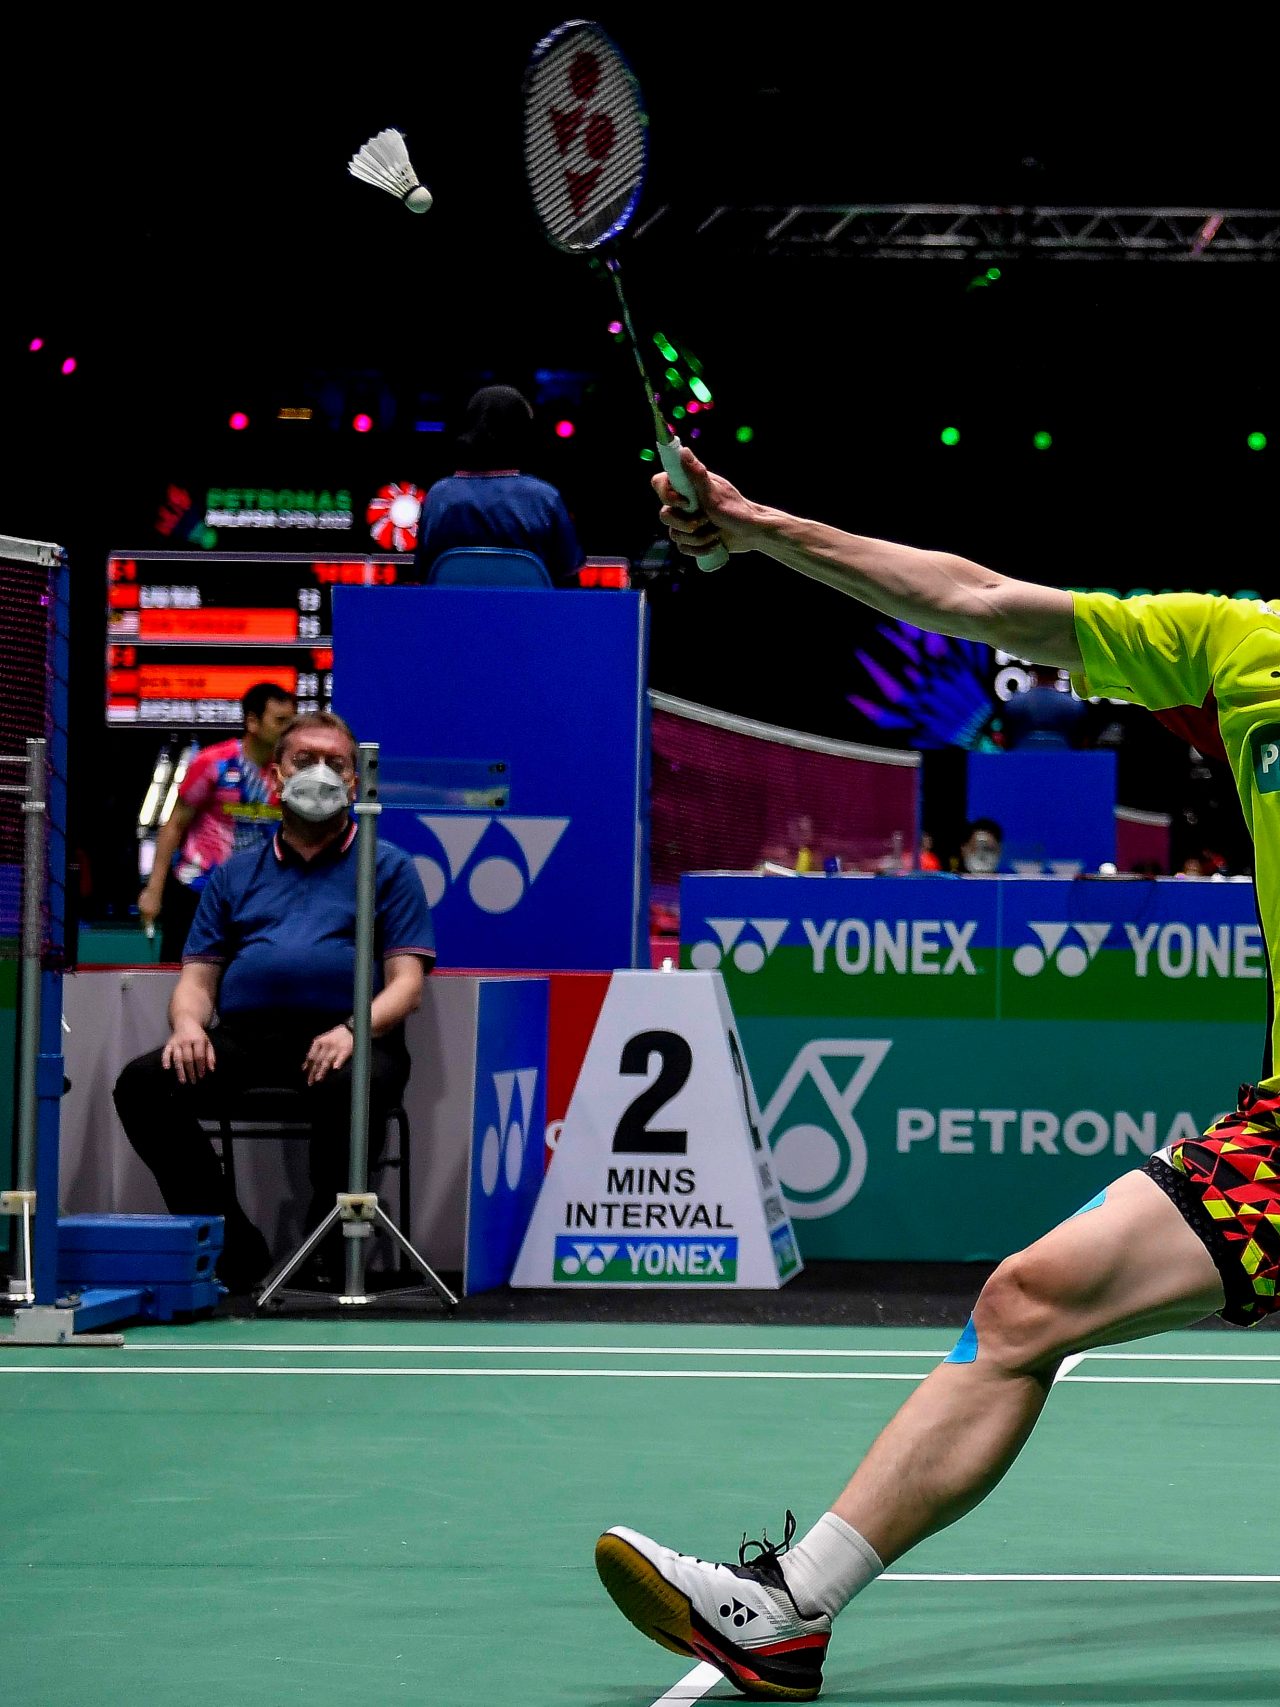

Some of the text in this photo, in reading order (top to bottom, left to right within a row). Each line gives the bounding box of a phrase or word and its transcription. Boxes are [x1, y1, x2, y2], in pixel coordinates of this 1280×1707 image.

[802, 919, 978, 975] YONEX
[1123, 922, 1267, 979] YONE
[612, 1030, 693, 1155] 2
[897, 1108, 1232, 1156] PETRONA
[607, 1167, 696, 1195] MINS
[565, 1202, 734, 1229] INTERVAL
[627, 1244, 725, 1275] YONEX
